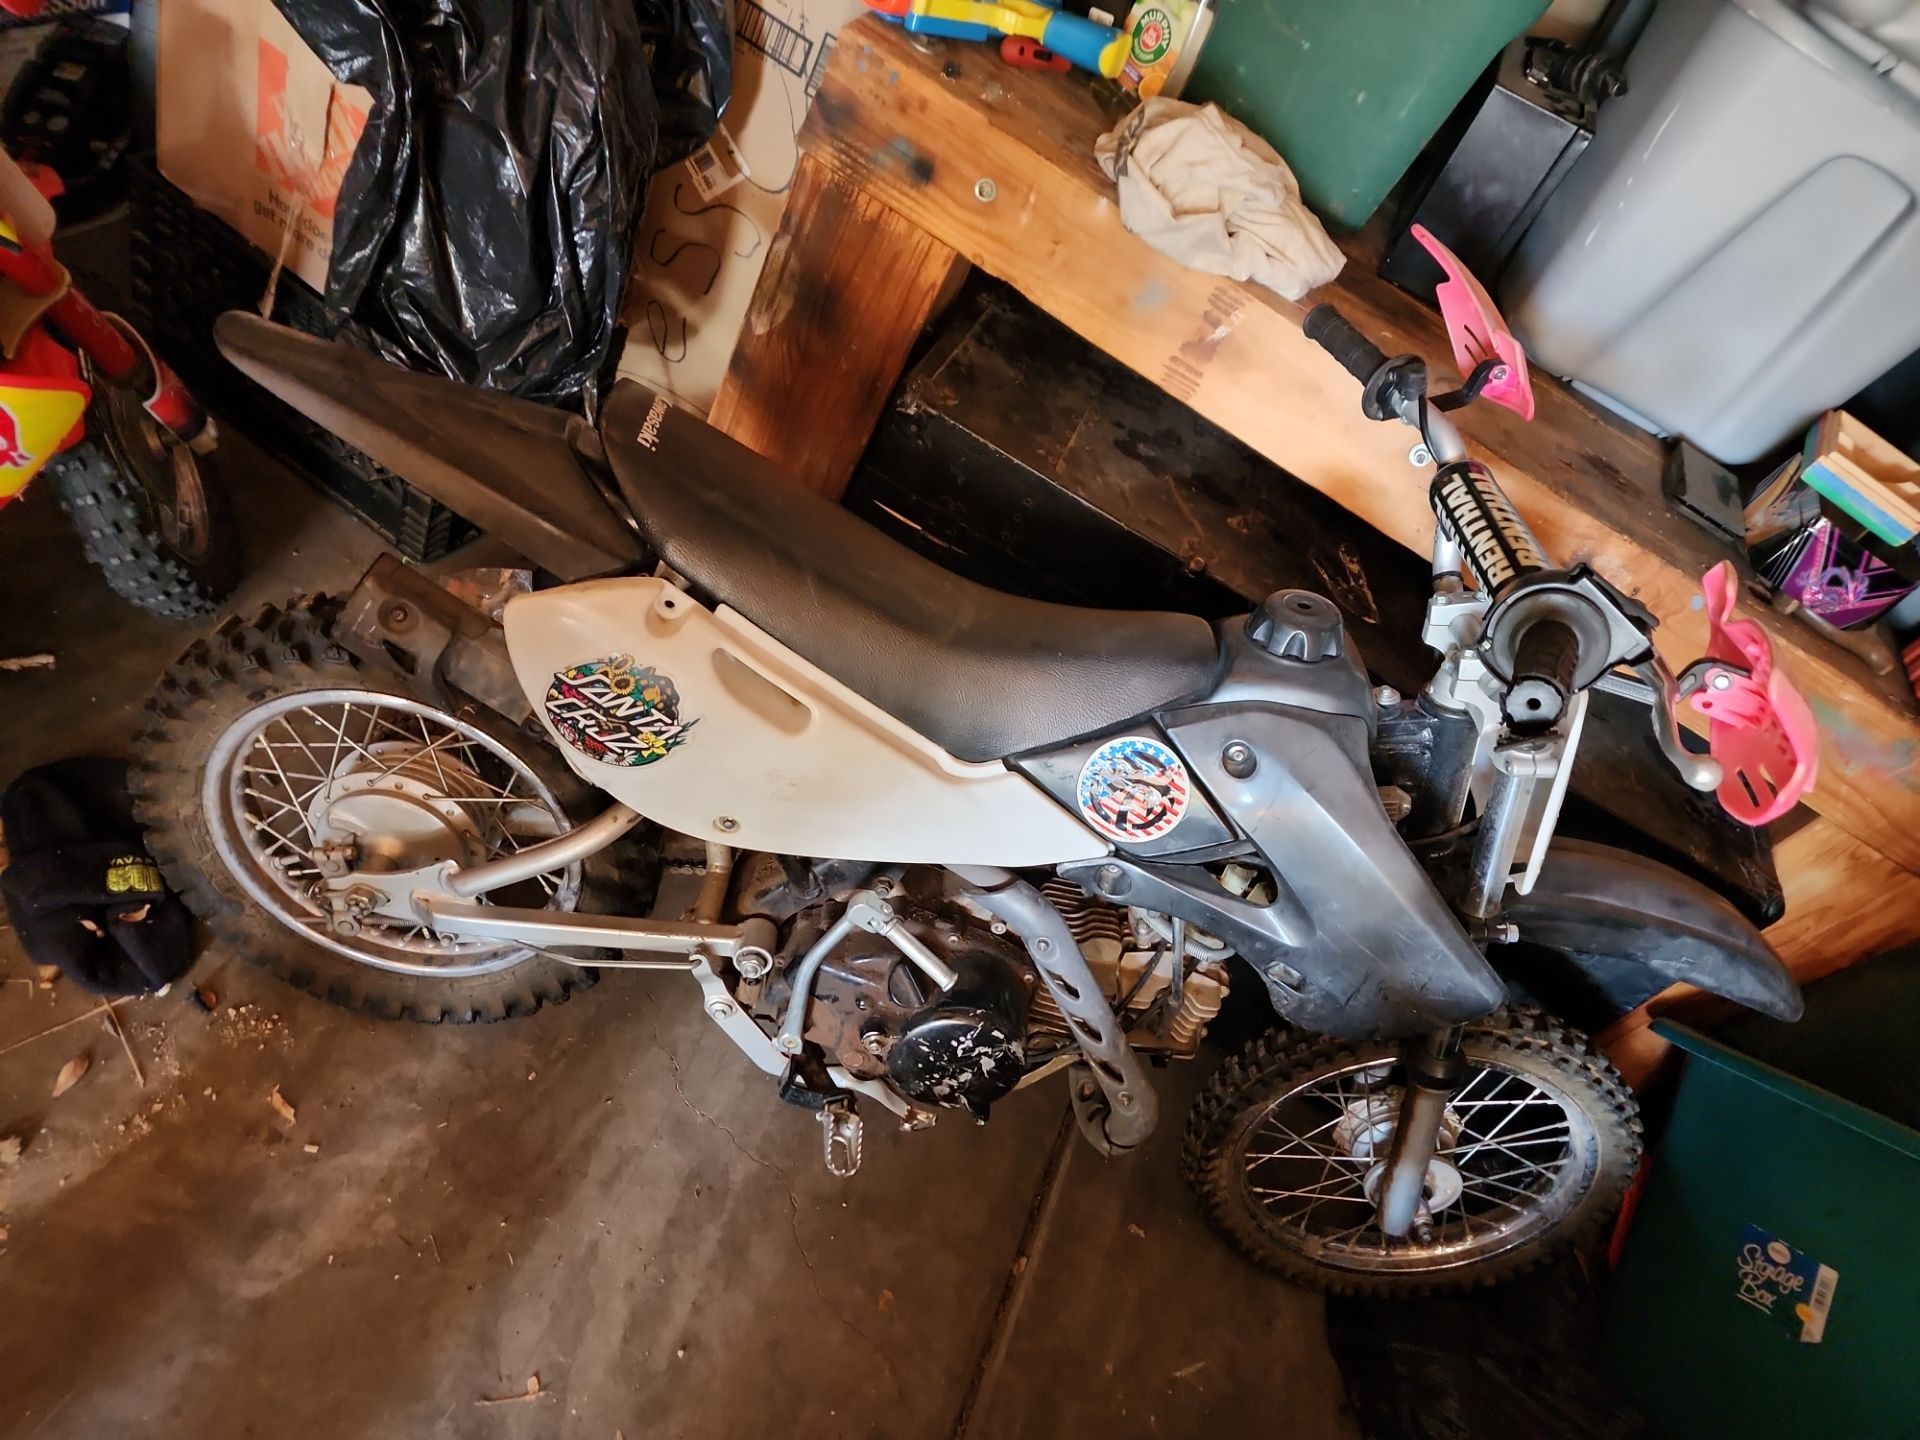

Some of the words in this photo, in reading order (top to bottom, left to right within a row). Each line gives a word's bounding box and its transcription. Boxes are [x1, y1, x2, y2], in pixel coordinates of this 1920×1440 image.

[1140, 10, 1170, 49] MURPHY
[1440, 472, 1516, 589] RENTHAL
[544, 697, 651, 754] CRUZ
[554, 672, 684, 742] SANTA
[1737, 1244, 1804, 1294] Storage
[1738, 1269, 1777, 1308] Box
